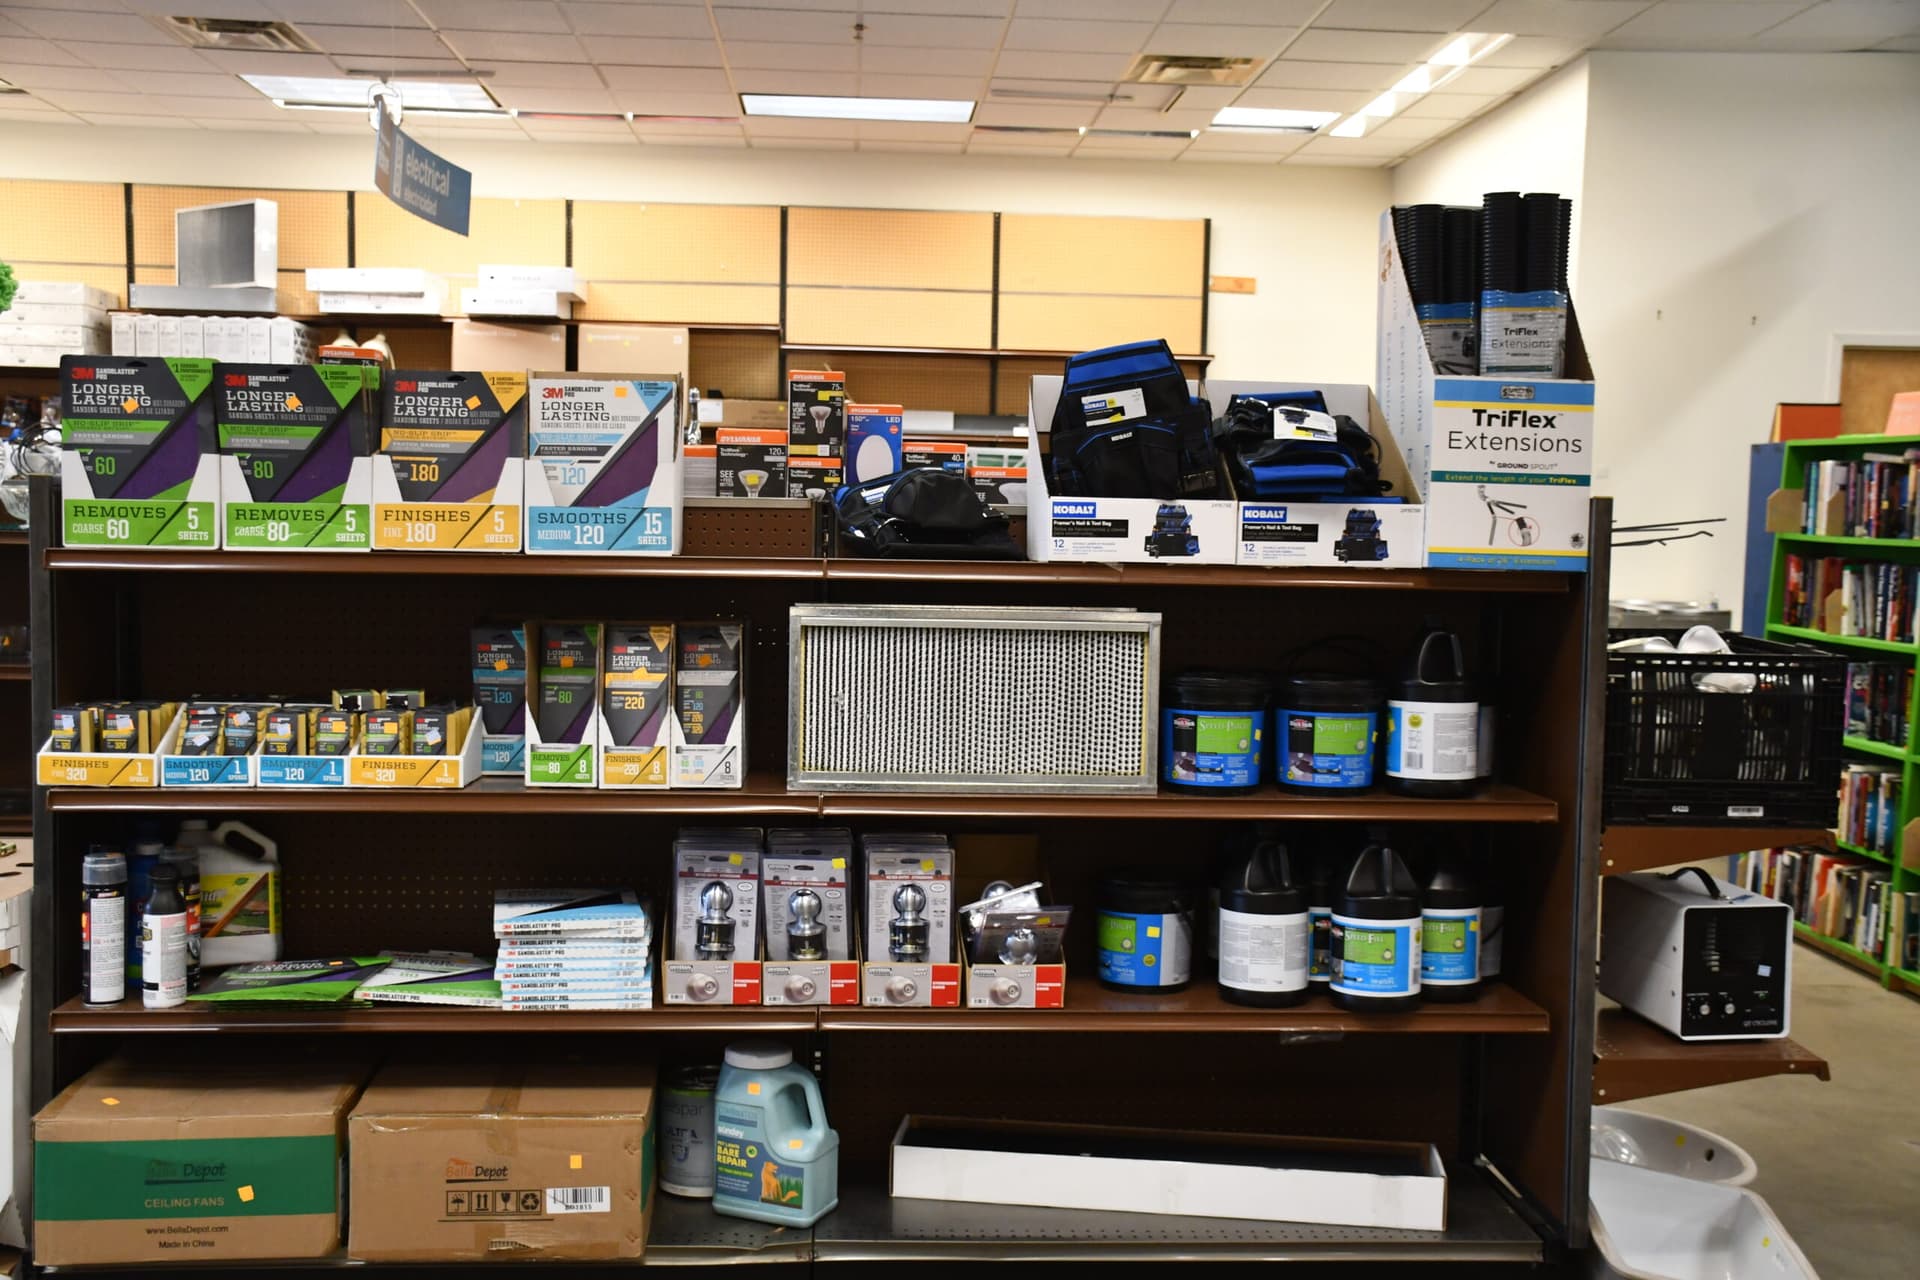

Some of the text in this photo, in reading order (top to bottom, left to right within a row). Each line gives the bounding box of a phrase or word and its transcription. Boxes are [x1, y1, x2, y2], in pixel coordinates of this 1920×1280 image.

[406, 147, 450, 197] electrical
[1504, 327, 1538, 336] TriFlex
[1491, 339, 1550, 349] Extensions
[71, 367, 95, 380] 3M
[225, 374, 248, 387] 3M
[394, 380, 417, 393] 3M
[71, 383, 146, 396] LONGER
[541, 387, 564, 399] 3M
[394, 395, 463, 407] LONGER
[541, 401, 605, 411] LONGER
[394, 406, 469, 418] LASTING
[541, 411, 610, 422] LASTING
[886, 416, 901, 424] LED
[1448, 430, 1583, 453] Extensions
[95, 457, 116, 475] 60
[253, 460, 274, 479] 80
[410, 463, 440, 482] 180
[1497, 462, 1528, 470] GROUND
[562, 467, 586, 486] 120
[719, 470, 735, 478] SEE
[1445, 474, 1577, 485] Extend the length of your TriFlex
[72, 505, 167, 519] REMOVES
[234, 508, 326, 522] REMOVES
[383, 509, 471, 523] FINISHES
[1053, 505, 1095, 515] KOBALT
[1244, 509, 1285, 519] KOBALT
[186, 507, 200, 530] 5
[345, 510, 357, 532] 5
[493, 511, 505, 534] 5
[536, 511, 627, 525] SMOOTHS
[643, 512, 662, 535] 15
[72, 519, 130, 540] COARSE 60
[177, 530, 209, 542] SHEETS
[234, 521, 290, 542] COARSE 80
[383, 522, 437, 543] FINE 180
[536, 524, 605, 545] MEDIUM 120
[335, 532, 366, 544] SHEETS
[484, 534, 515, 544] SHEETS
[637, 535, 667, 546] SHEETS
[1053, 539, 1065, 548] 12
[1244, 543, 1255, 552] 12
[494, 691, 512, 704] 120
[558, 691, 572, 704] 80
[624, 696, 645, 710] 220
[483, 743, 514, 751] MOOTHS
[262, 759, 318, 768] SMOOTHS
[495, 752, 510, 762] 120
[52, 759, 109, 769] FINISHES
[136, 762, 144, 776] 1
[165, 760, 223, 769] SMOOTHS
[234, 760, 241, 775] 1
[329, 761, 336, 775] 1
[362, 761, 417, 770] FINISHES
[442, 763, 449, 776] 1
[579, 759, 587, 773] 8
[624, 764, 639, 775] 220
[652, 760, 660, 774] 8
[724, 761, 731, 774] 8
[66, 768, 88, 781] 320
[189, 769, 210, 782] 120
[285, 768, 305, 781] 120
[376, 769, 396, 782] 320
[717, 1145, 739, 1158] BARE
[717, 1154, 748, 1168] REPAIR
[144, 1196, 225, 1208] CEILING FANS
[183, 1240, 191, 1248] in
